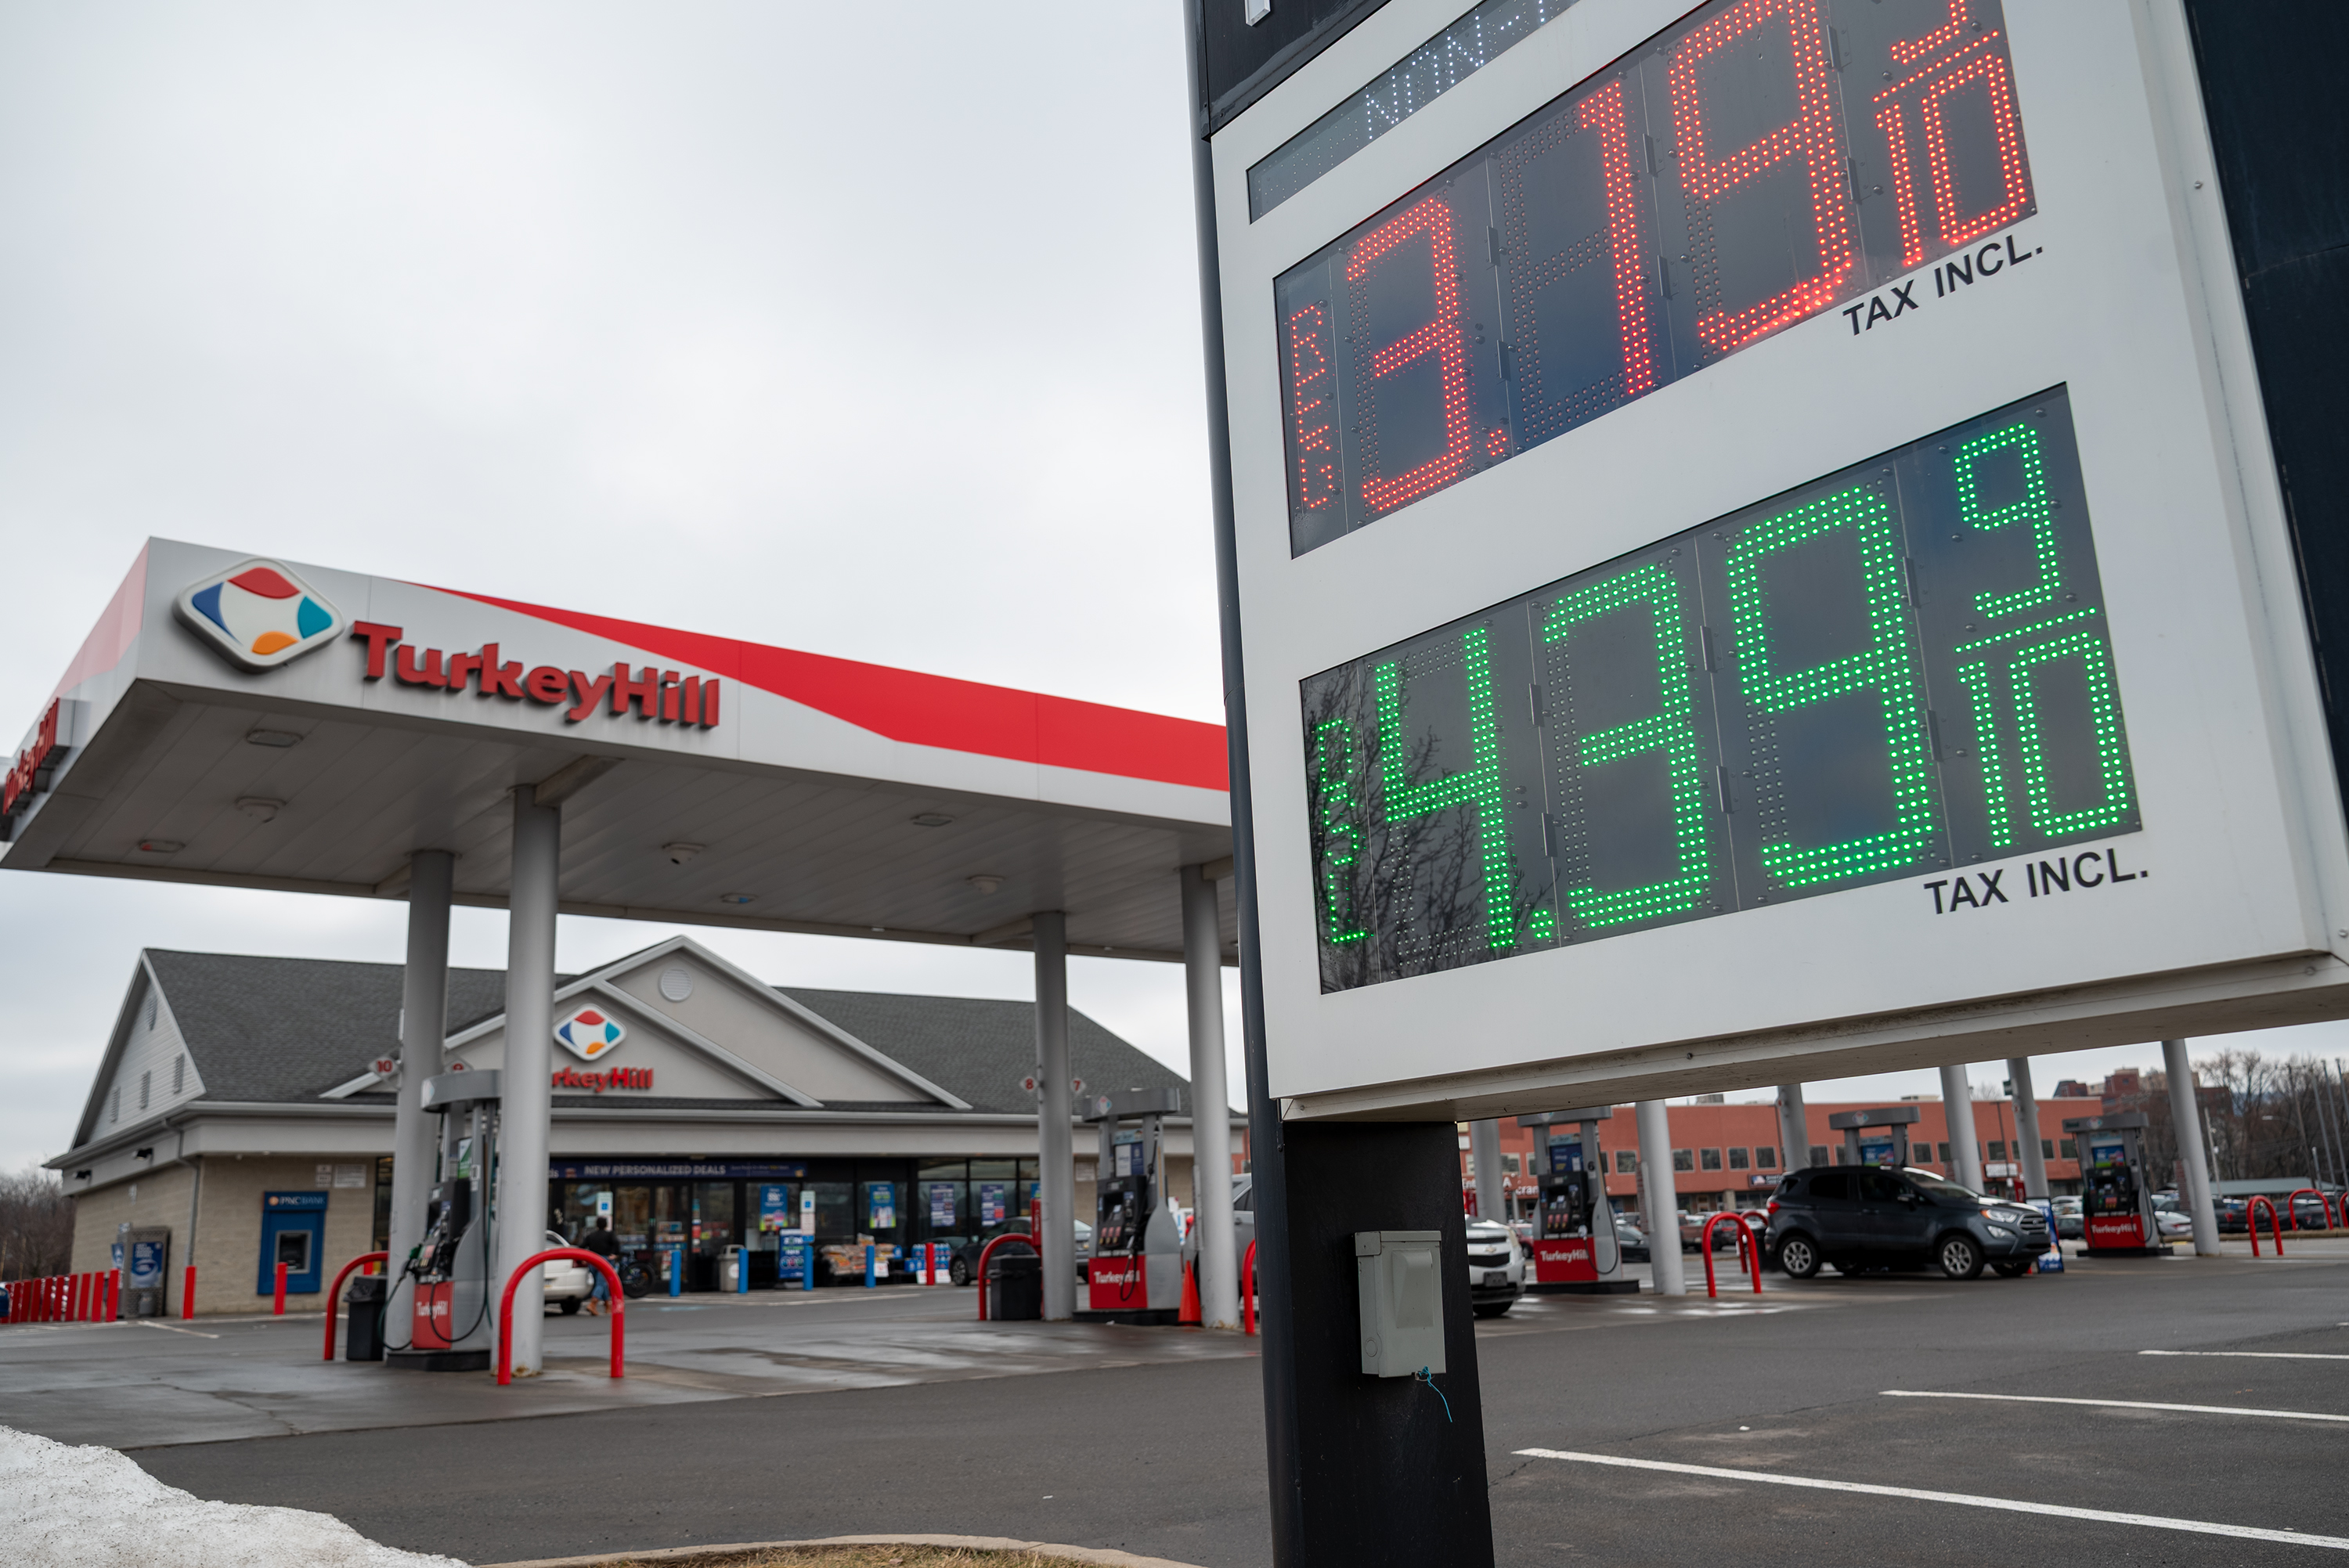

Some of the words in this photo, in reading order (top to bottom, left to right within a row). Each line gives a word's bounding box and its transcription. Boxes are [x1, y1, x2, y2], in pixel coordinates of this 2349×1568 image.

[1346, 0, 1853, 511] 3.19
[1842, 279, 1920, 336] TAX
[1934, 234, 2043, 298] INCL.
[1290, 305, 1333, 509] REG
[1954, 423, 2061, 618] 9
[1375, 486, 1933, 948] 4.39
[1317, 719, 1366, 943] DSL
[1924, 869, 2008, 914] TAX
[2027, 846, 2149, 898] INCL.
[377, 1060, 393, 1073] 10
[551, 1065, 654, 1093] rkeyHill
[1025, 1078, 1034, 1090] 8
[1073, 1080, 1081, 1091] 7
[584, 1165, 609, 1176] NEW
[612, 1165, 691, 1176] PERSONALIZED
[693, 1165, 726, 1176] DEALS
[1587, 1161, 1595, 1171] 6
